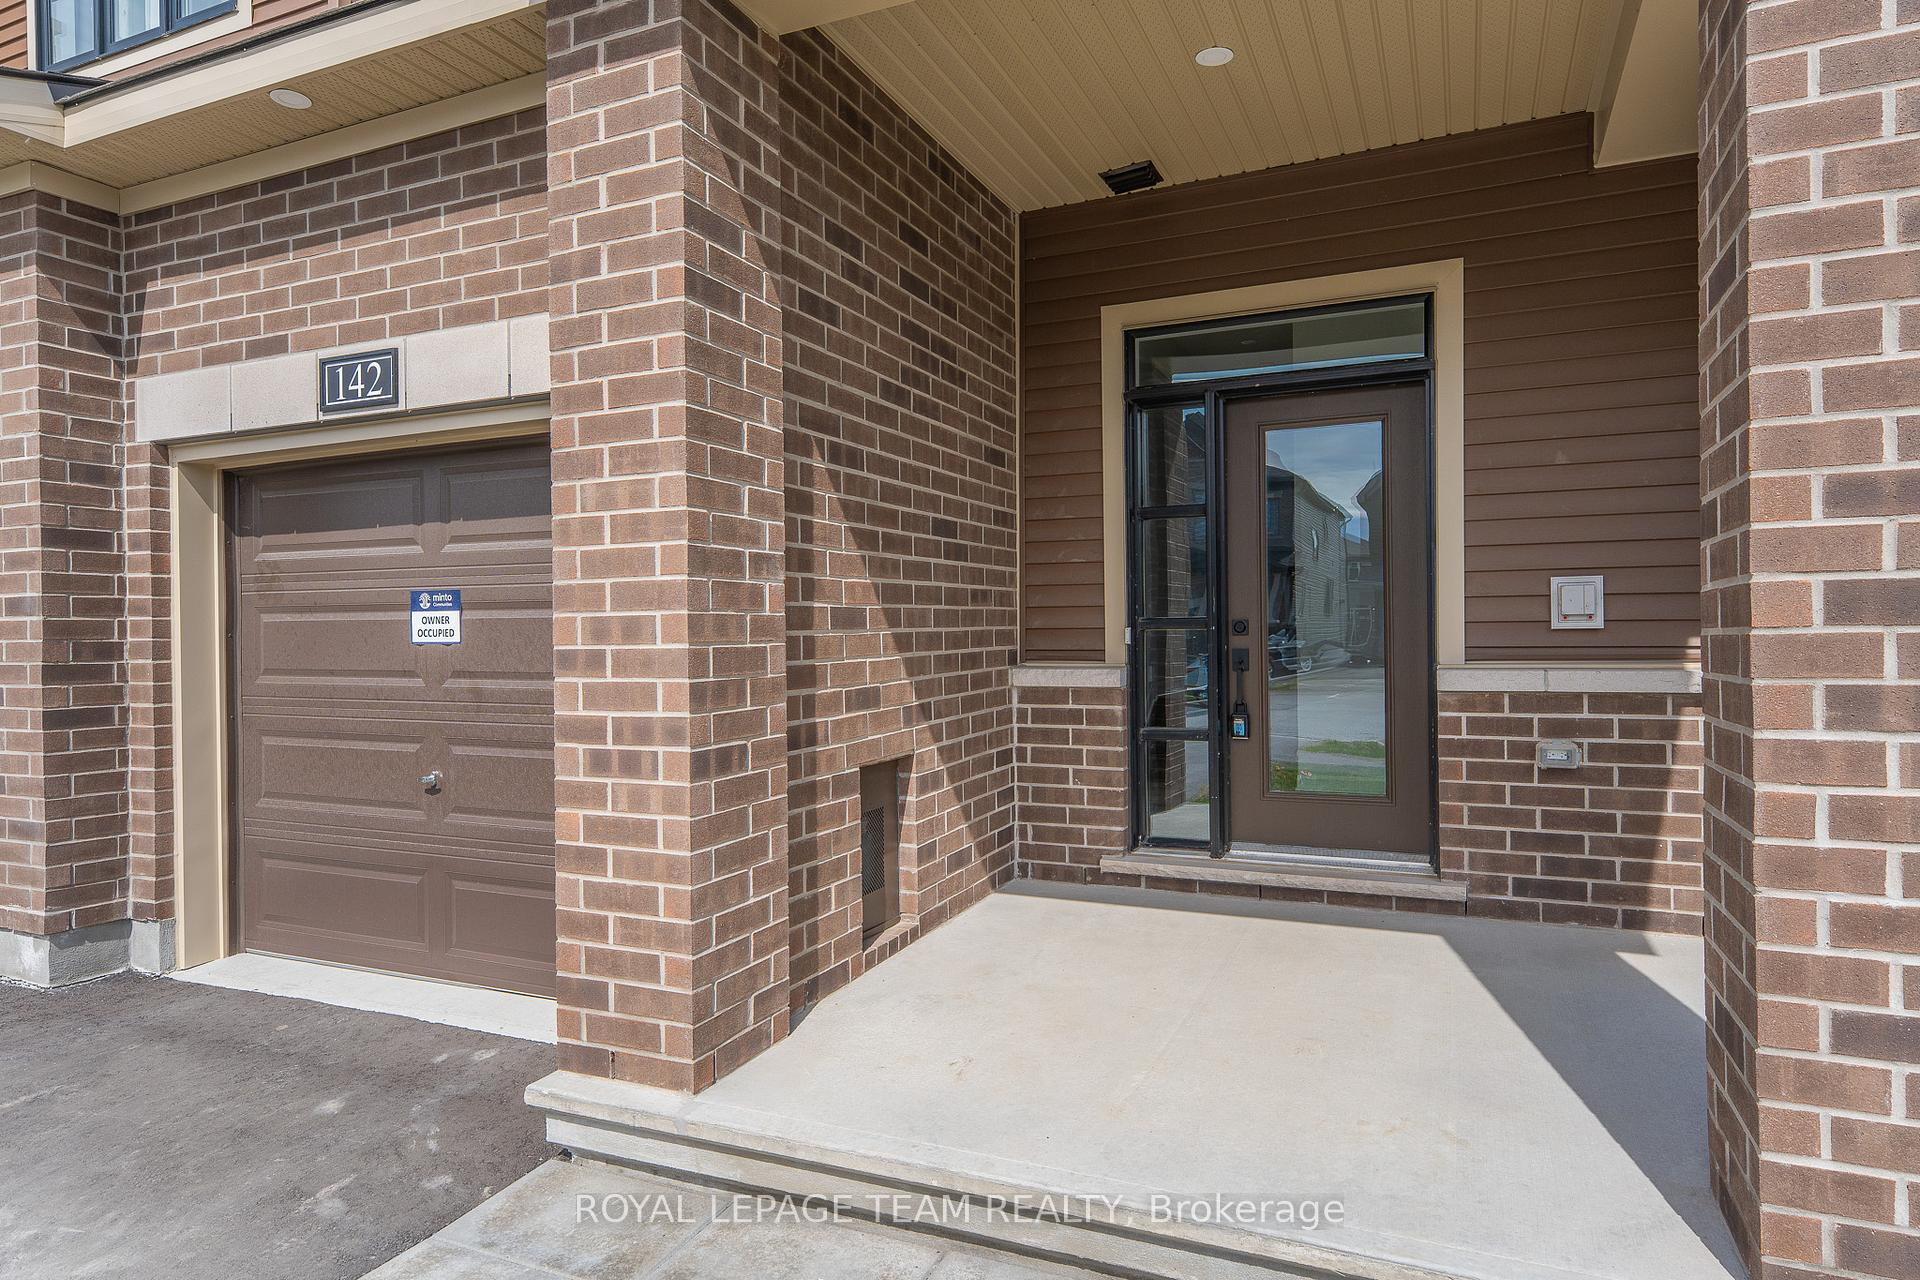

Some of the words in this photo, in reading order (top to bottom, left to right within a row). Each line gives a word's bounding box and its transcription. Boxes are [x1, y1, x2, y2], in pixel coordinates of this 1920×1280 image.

[335, 361, 383, 400] 142
[432, 592, 452, 601] minto
[421, 615, 450, 624] OWNER
[417, 628, 455, 637] OCCUPIED
